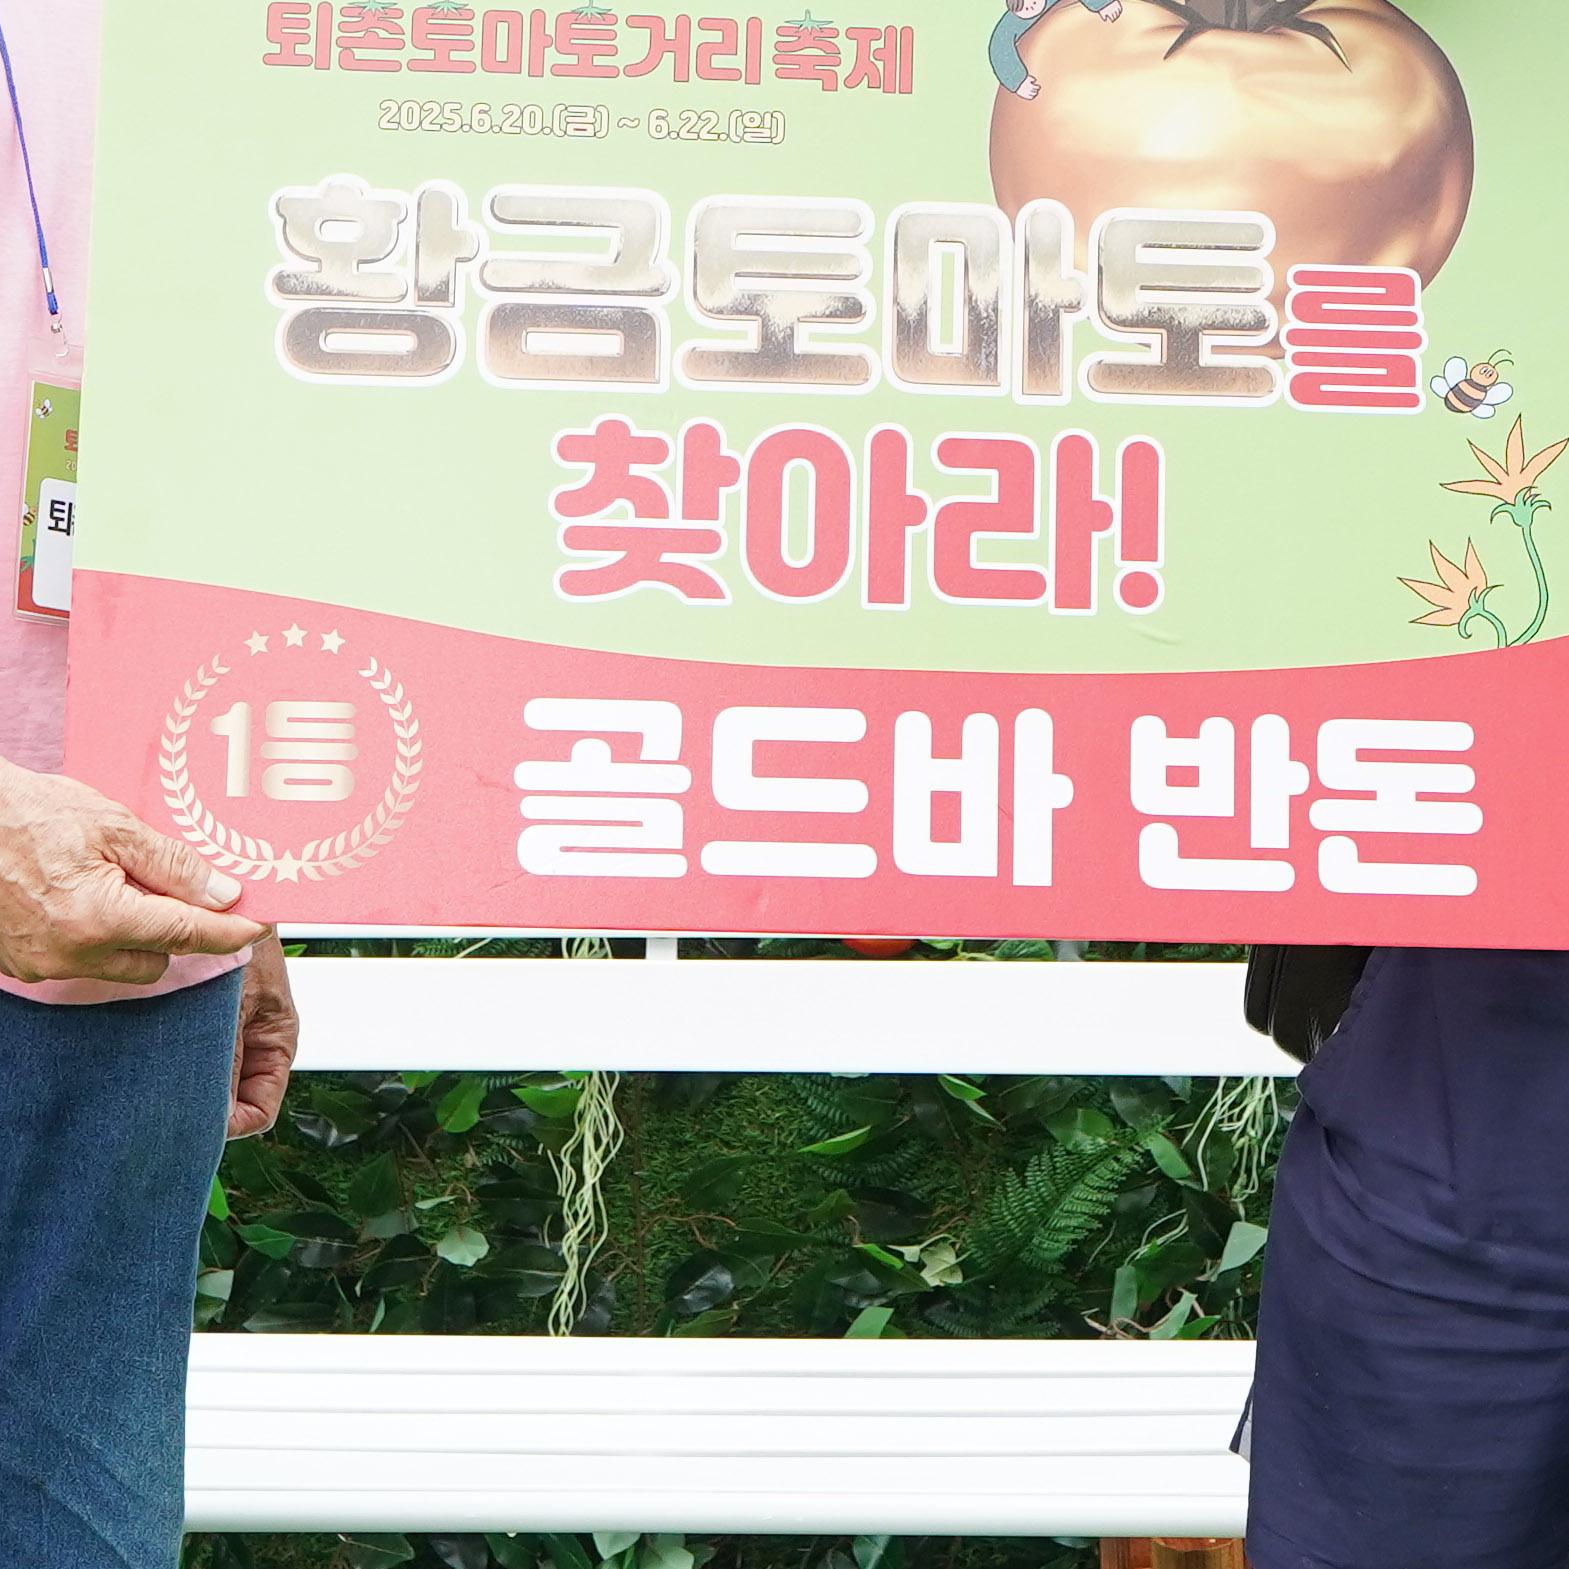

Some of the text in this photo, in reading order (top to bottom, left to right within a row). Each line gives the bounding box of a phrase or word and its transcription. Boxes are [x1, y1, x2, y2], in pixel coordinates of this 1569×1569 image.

[647, 108, 786, 144] 6.22.(일)
[270, 181, 1423, 411] 황금토마토를
[47, 498, 77, 536] 퇴
[551, 417, 1165, 610] 찾아라!
[211, 699, 358, 802] 1등
[513, 696, 1484, 897] 골드바 반돈
